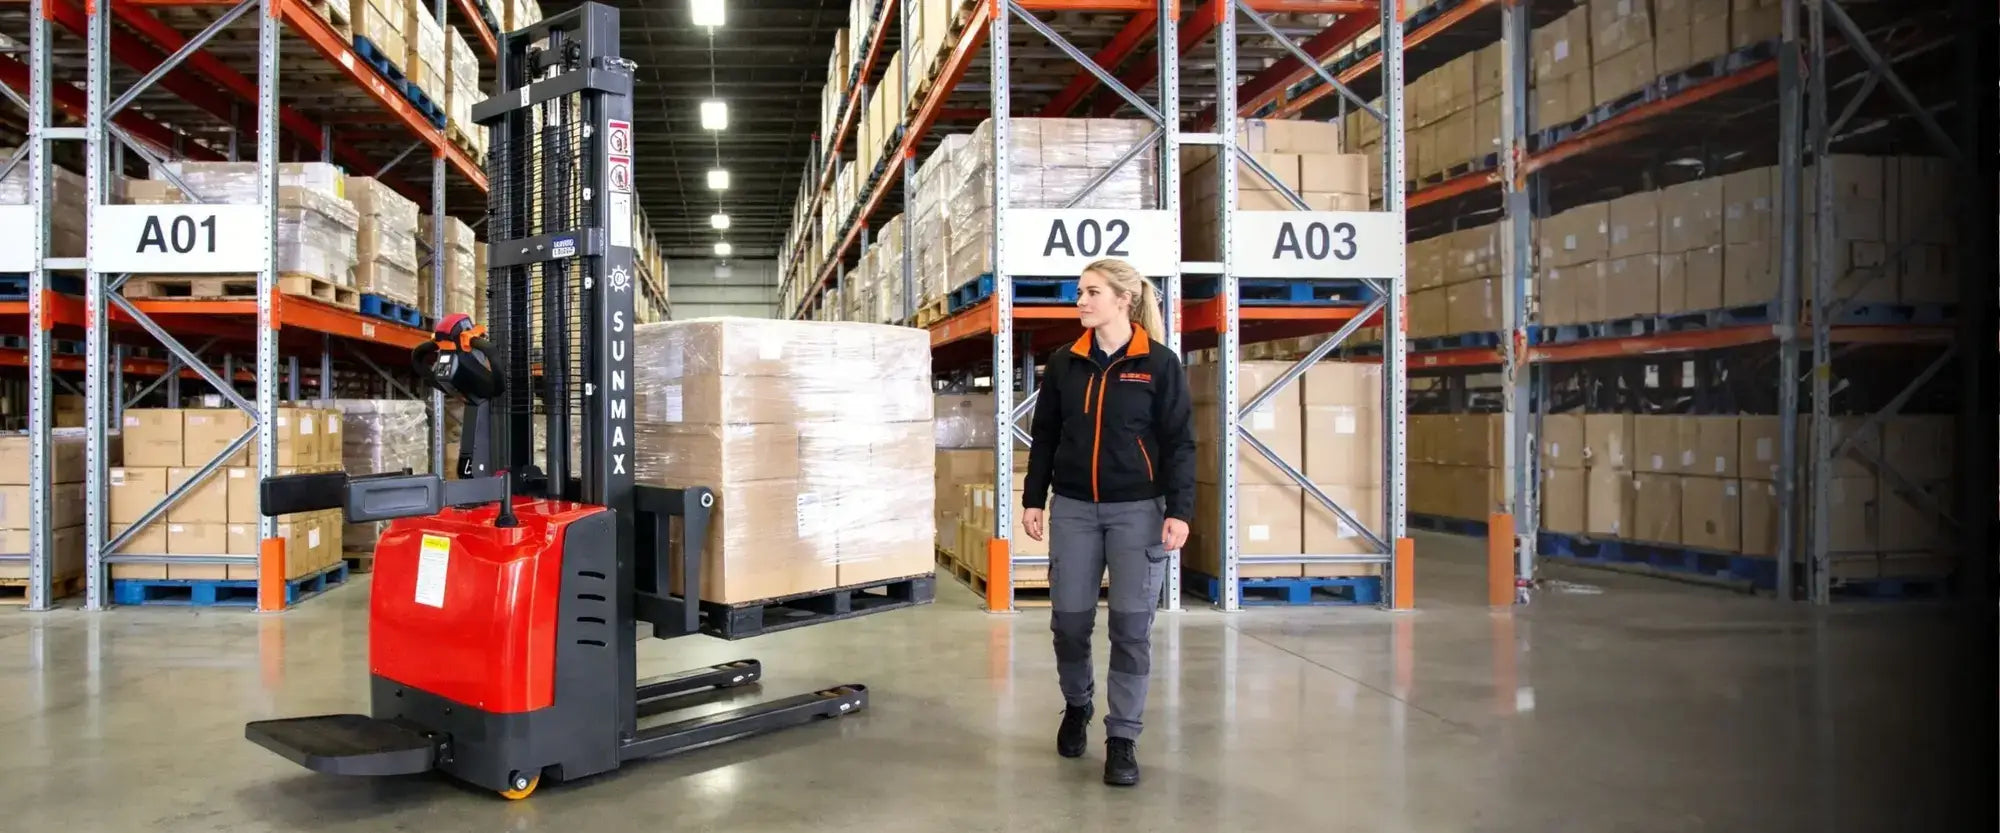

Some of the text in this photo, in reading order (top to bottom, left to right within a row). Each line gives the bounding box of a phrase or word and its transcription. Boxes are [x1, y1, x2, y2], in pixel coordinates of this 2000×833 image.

[136, 215, 216, 254] A01
[1043, 219, 1130, 257] A02
[1273, 222, 1357, 261] A03
[610, 310, 627, 475] SUNMAX
